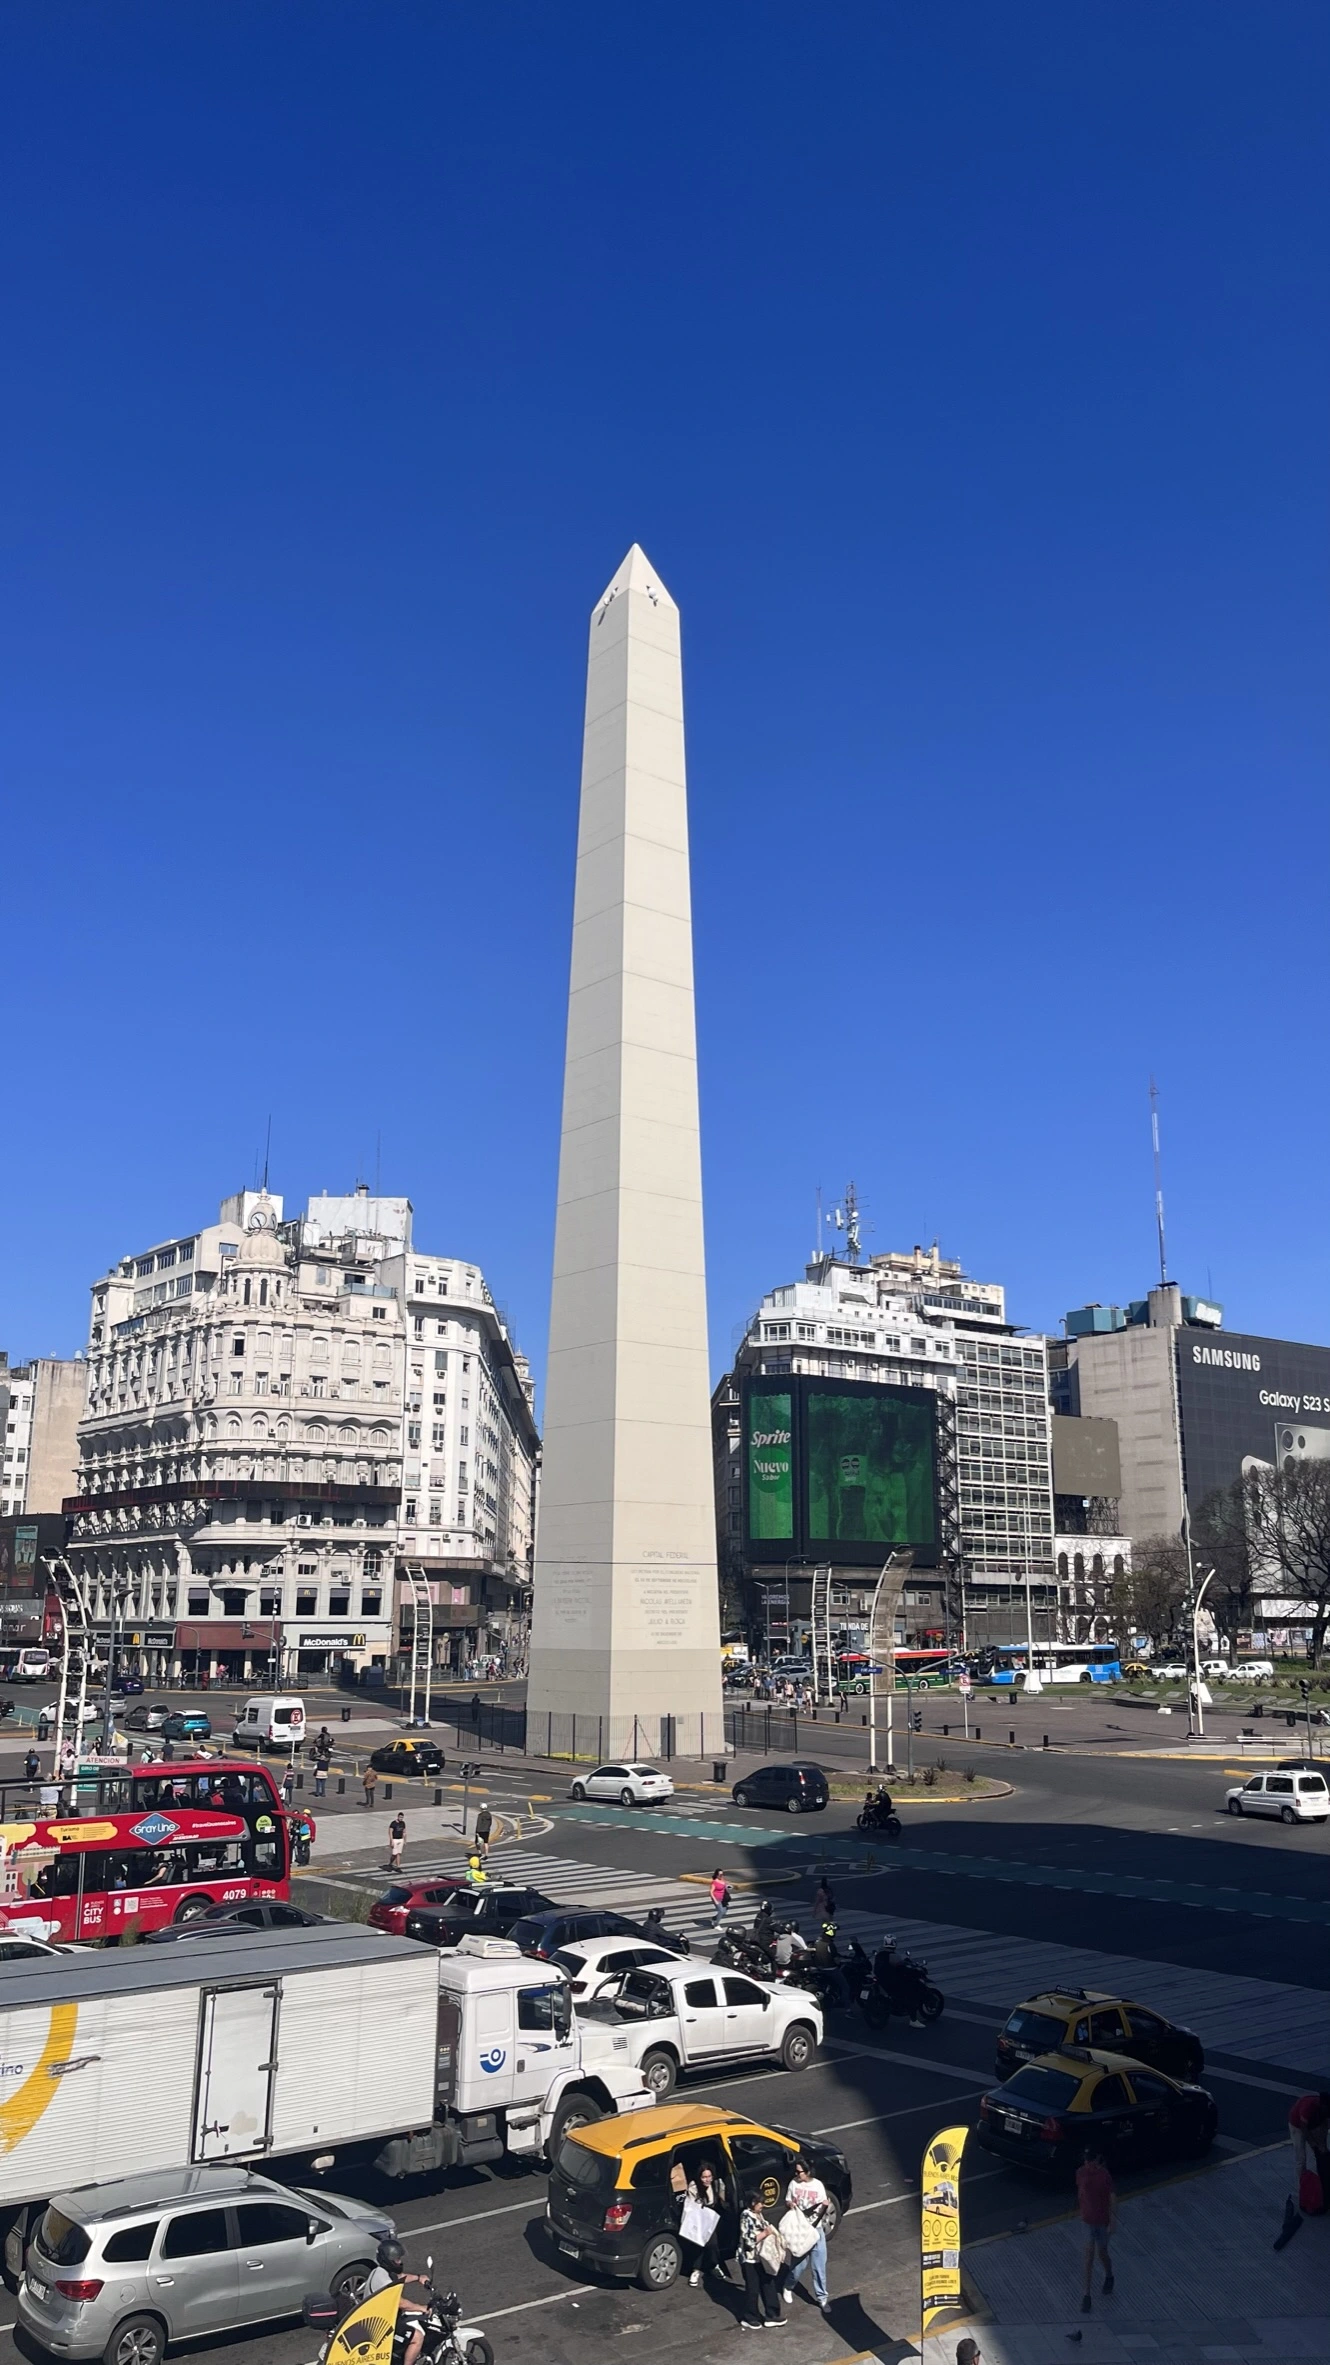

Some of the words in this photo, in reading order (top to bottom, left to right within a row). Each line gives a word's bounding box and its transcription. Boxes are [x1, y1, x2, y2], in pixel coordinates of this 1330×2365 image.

[1192, 1345, 1261, 1371] SAMSUNG
[1259, 1389, 1301, 1413] Galaxy
[1302, 1394, 1322, 1411] S23
[751, 1429, 791, 1448] Sprite
[753, 1459, 789, 1473] Nuevo
[642, 1551, 664, 1559] CAPITAL
[665, 1551, 689, 1560] FEDERAL
[840, 1622, 860, 1631] TINDA
[861, 1622, 869, 1631] DE
[303, 1638, 349, 1646] McDonald's
[222, 1888, 247, 1901] 4079
[83, 1907, 104, 1917] CITY
[83, 1916, 102, 1925] BUS
[0, 2062, 24, 2075] ino
[375, 2352, 391, 2361] BUS
